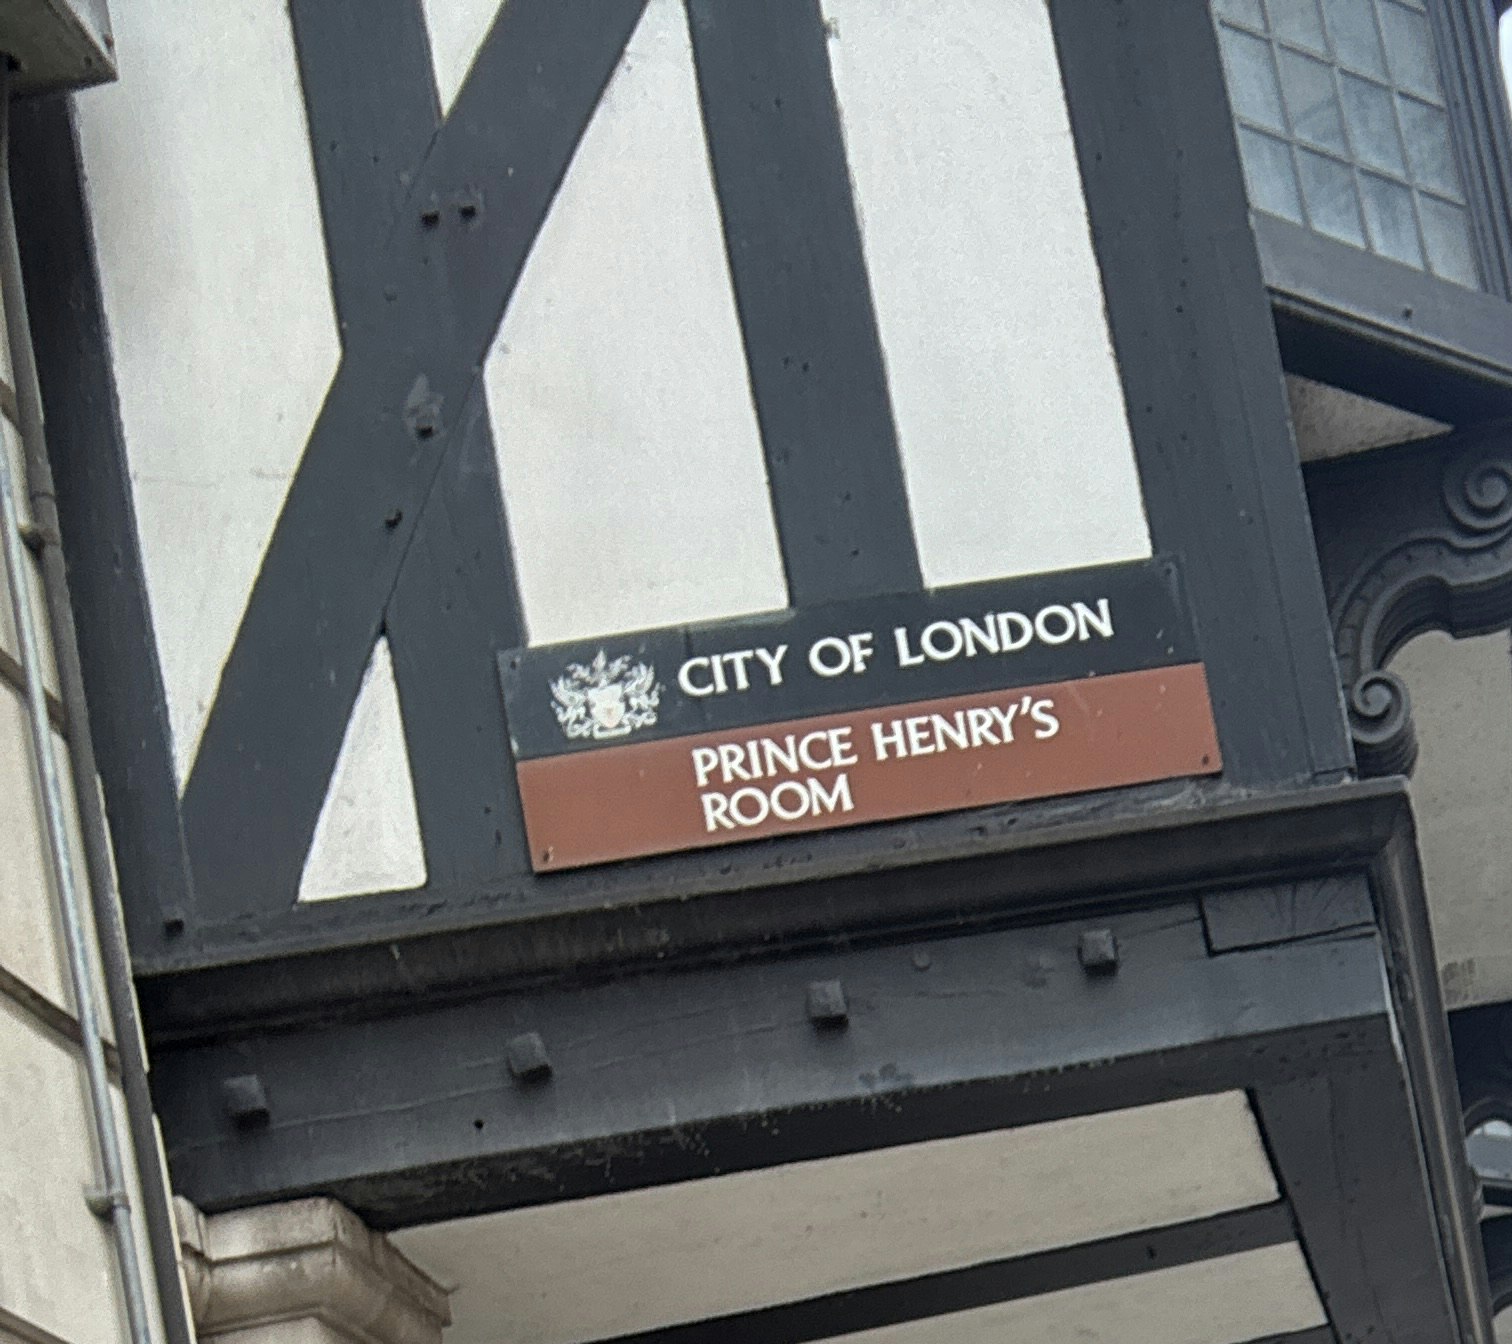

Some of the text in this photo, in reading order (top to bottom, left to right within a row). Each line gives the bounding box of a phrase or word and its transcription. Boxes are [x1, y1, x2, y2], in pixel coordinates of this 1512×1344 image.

[677, 598, 1115, 696] CITY OF LONDON
[691, 696, 1060, 786] PRINCE HENRY'S
[702, 774, 855, 831] ROOM
